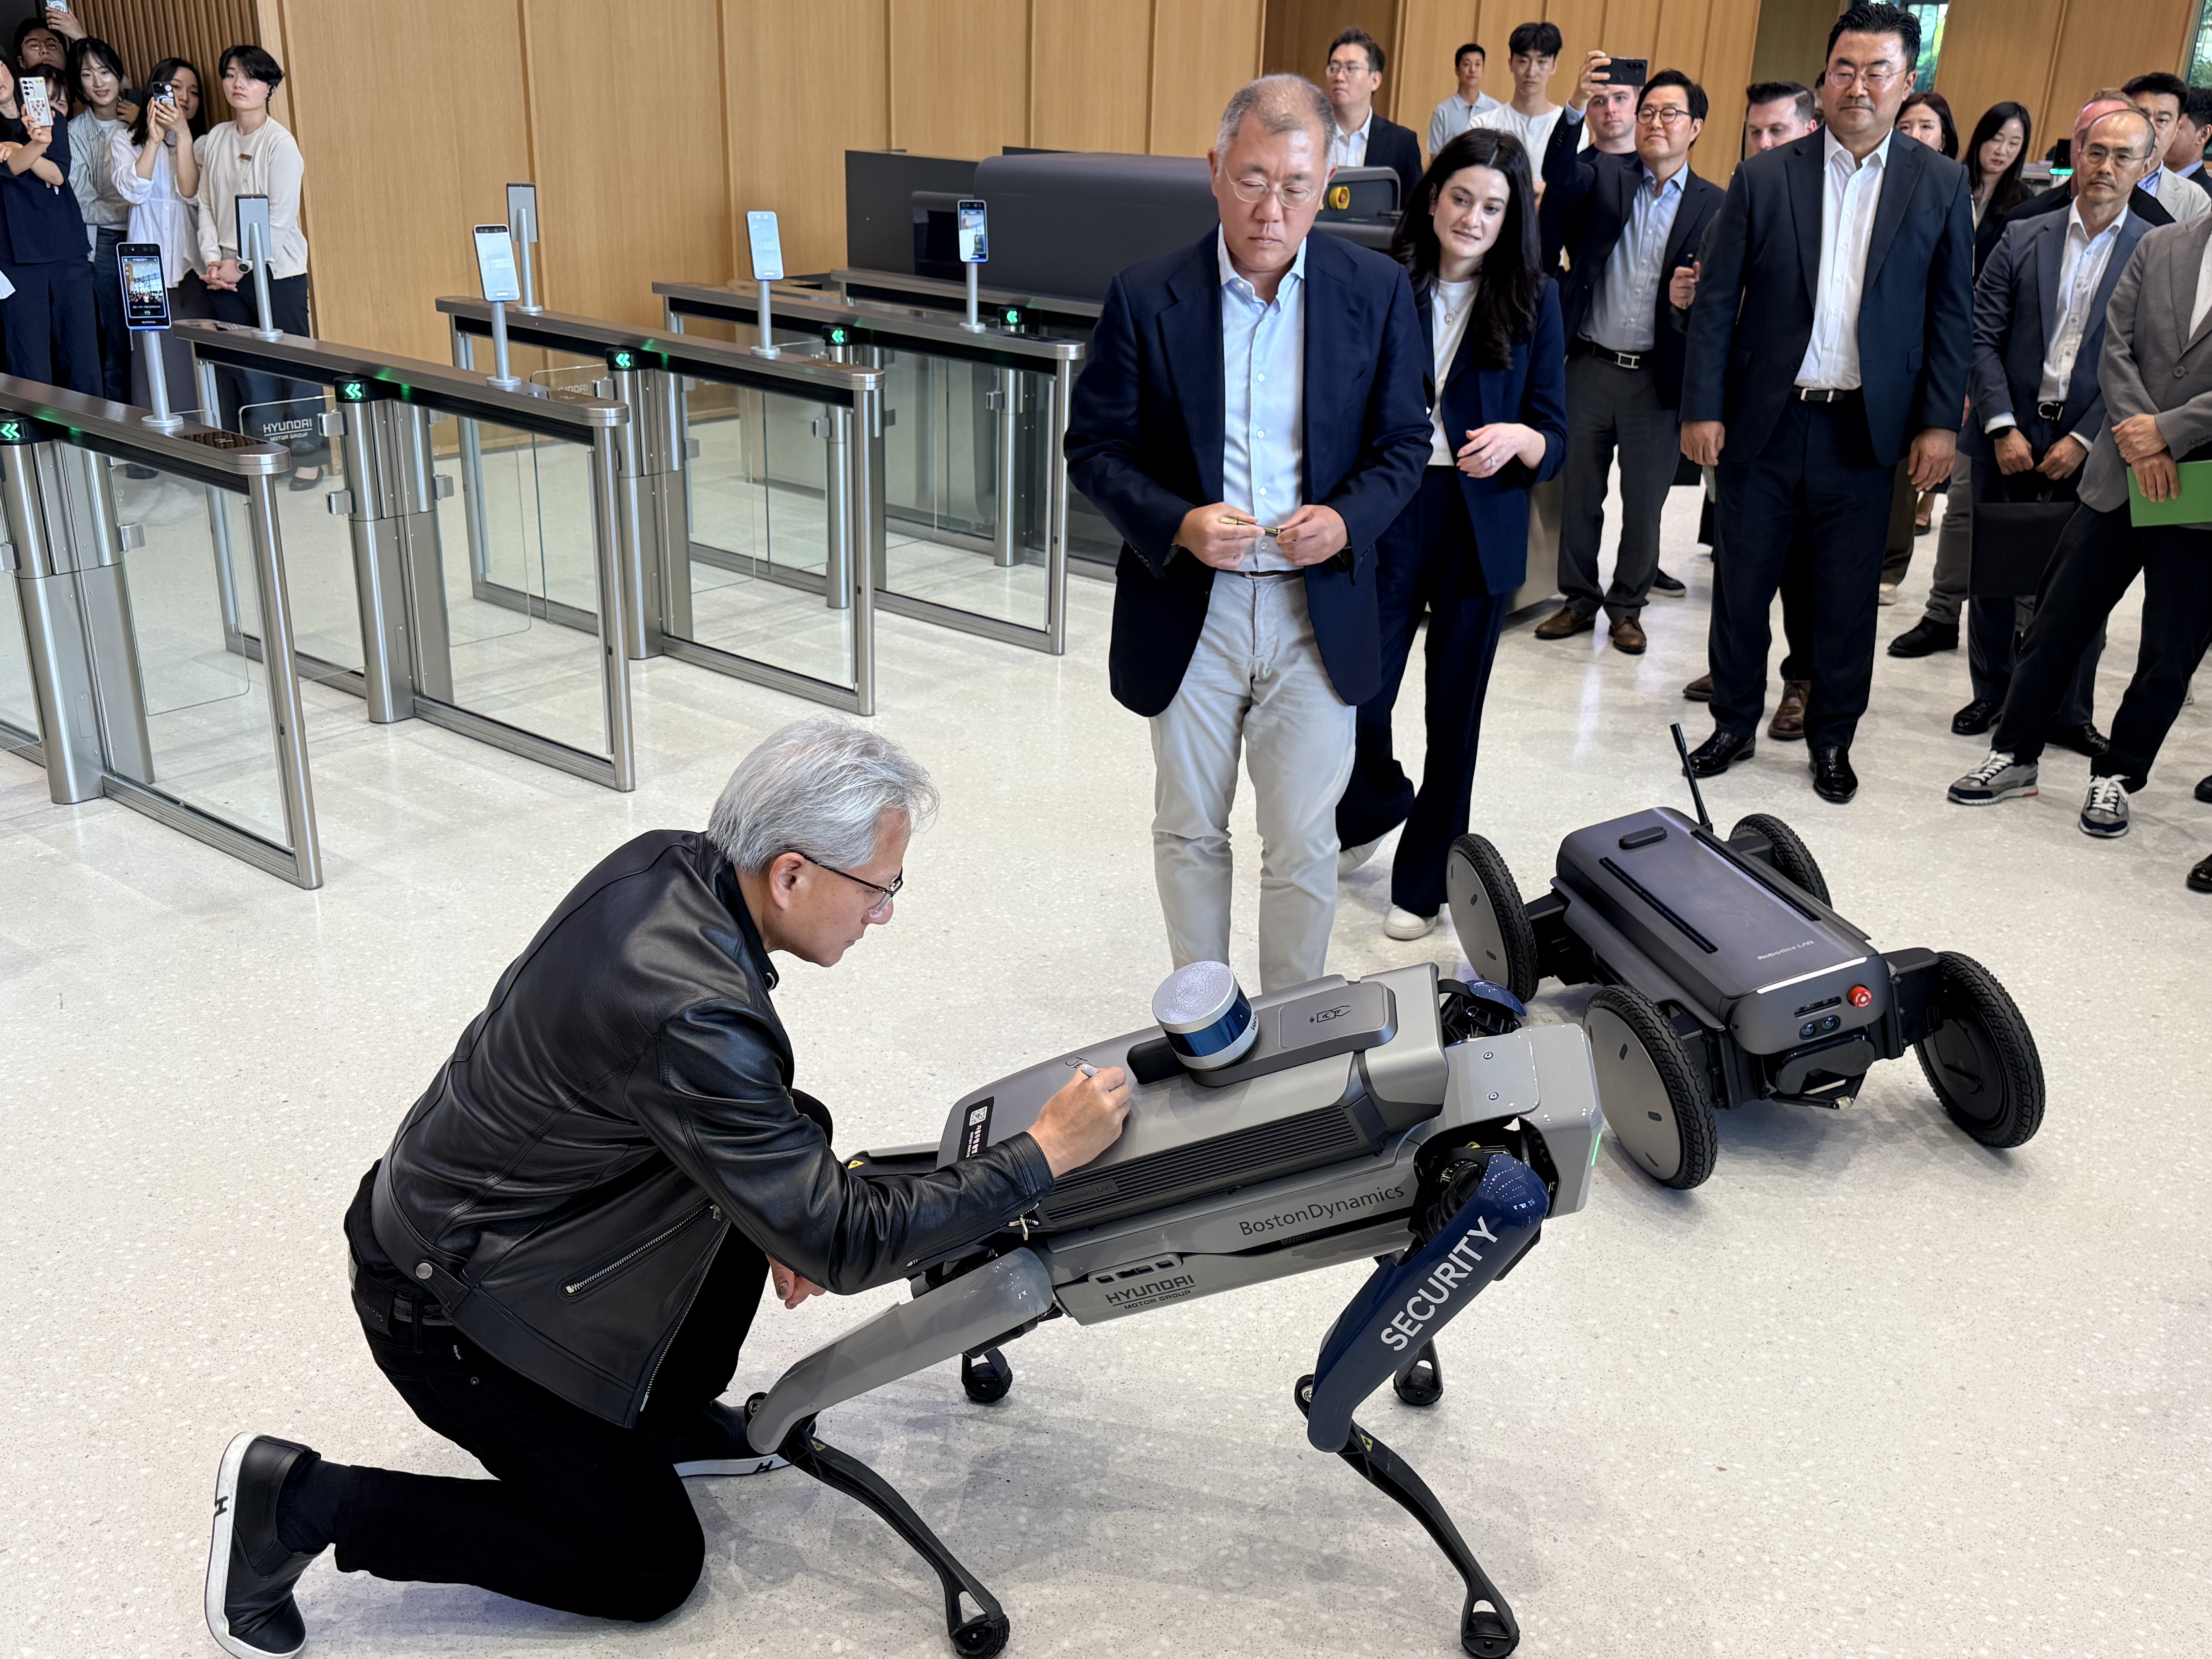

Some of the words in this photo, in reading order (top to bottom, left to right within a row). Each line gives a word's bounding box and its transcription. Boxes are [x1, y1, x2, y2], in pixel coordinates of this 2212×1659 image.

[263, 418, 313, 433] HYUNDAI
[1239, 1186, 1404, 1236] BostonDynamics
[1105, 1274, 1195, 1304] HYUNDAI
[1381, 1216, 1498, 1351] SECURITY
[1124, 1298, 1156, 1309] MOTOR
[1159, 1290, 1191, 1301] GROUP
